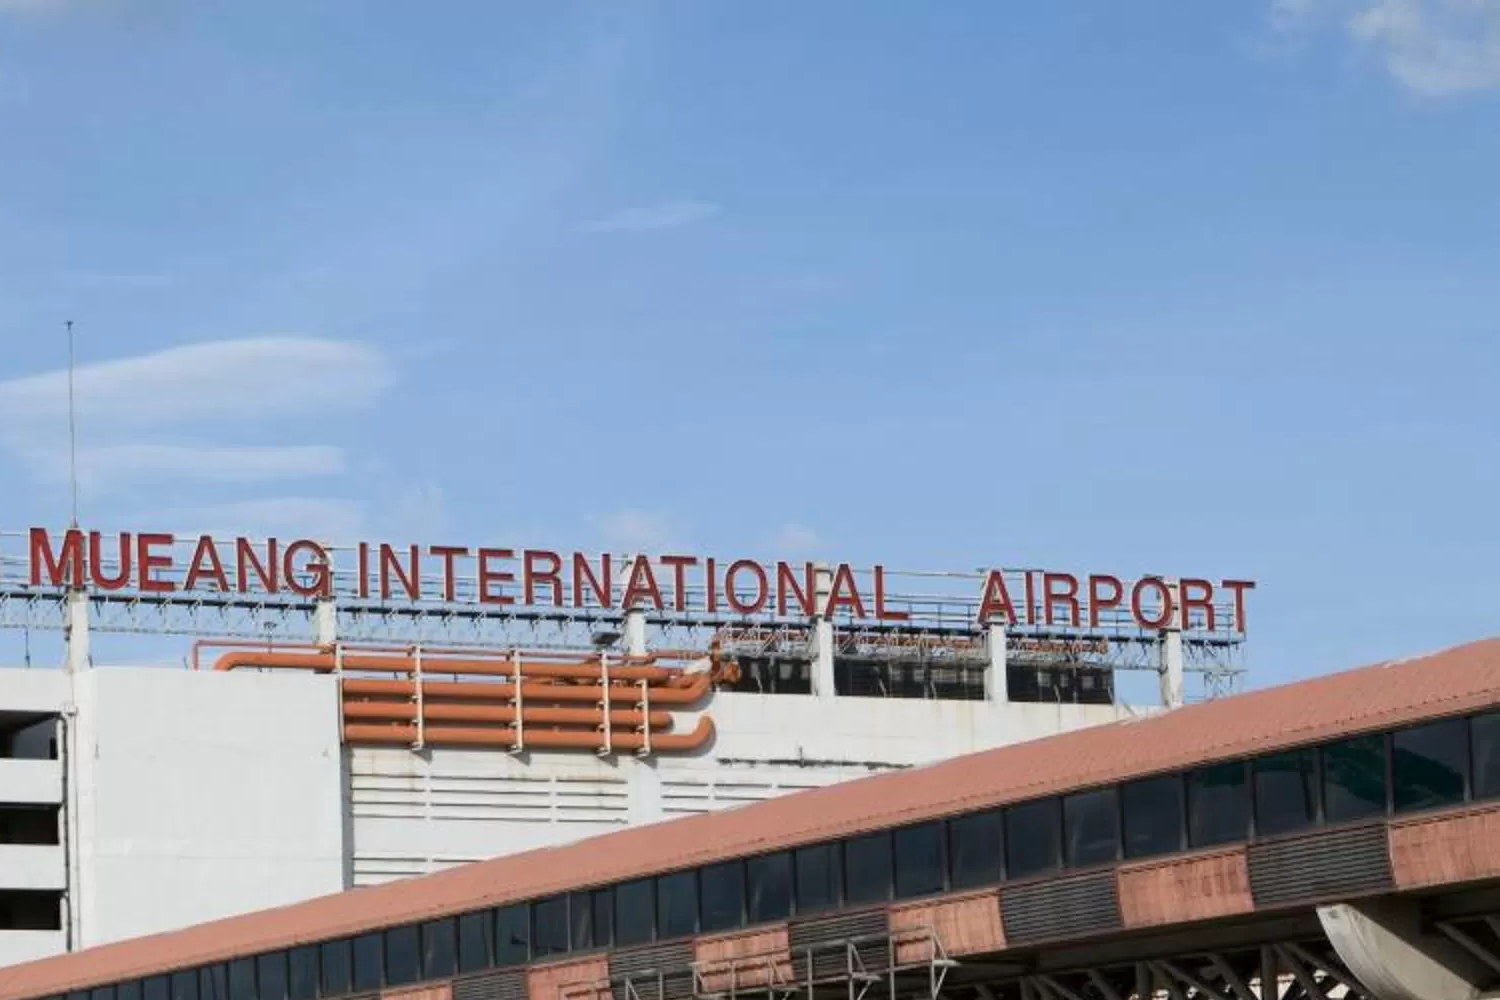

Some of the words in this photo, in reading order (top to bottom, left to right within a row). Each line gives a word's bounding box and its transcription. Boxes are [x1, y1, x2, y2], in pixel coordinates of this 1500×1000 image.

[29, 526, 333, 598] MUEANG
[358, 541, 910, 621] INTERNATIONAL
[977, 569, 1256, 633] AIRPORT
